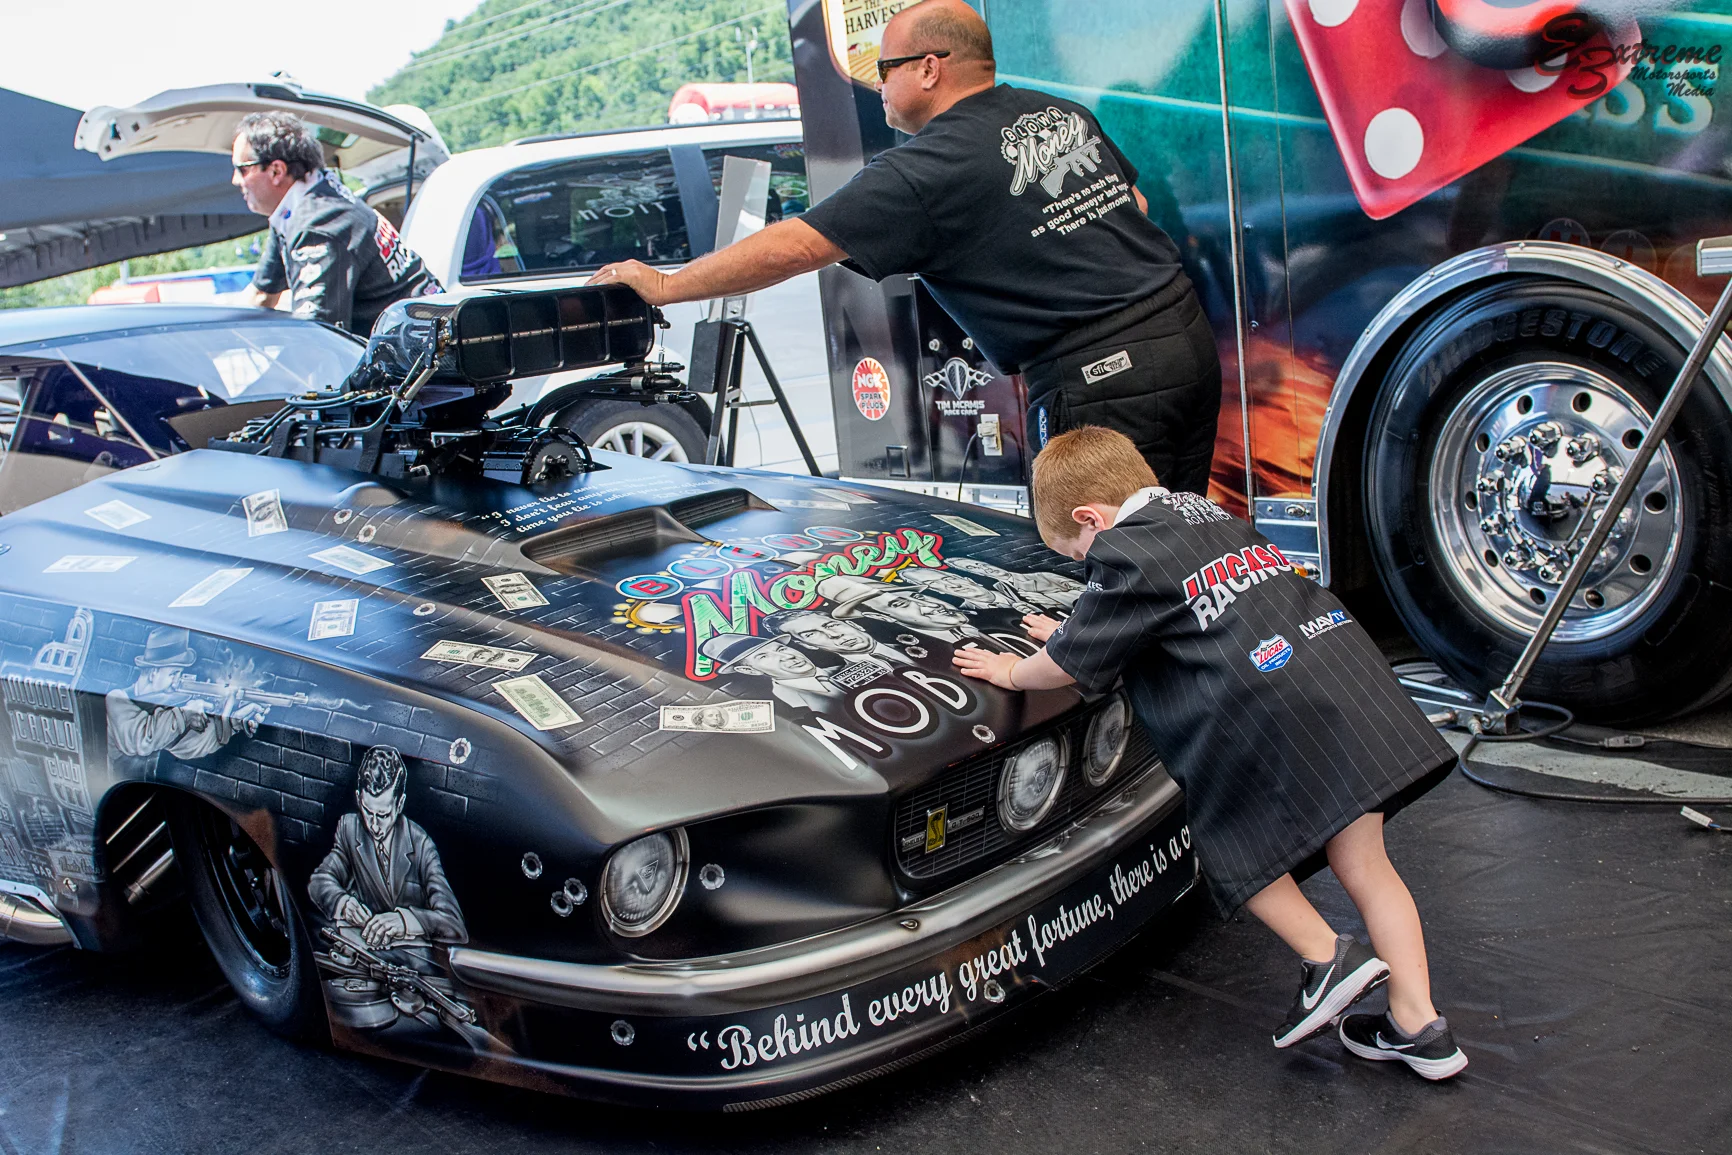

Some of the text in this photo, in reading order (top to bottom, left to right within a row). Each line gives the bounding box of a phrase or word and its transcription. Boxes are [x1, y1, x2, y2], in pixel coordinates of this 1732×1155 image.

[1002, 107, 1063, 143] BLOWN
[1010, 112, 1088, 196] Money
[1081, 187, 1091, 197] no
[1030, 225, 1046, 238] as
[1046, 209, 1073, 230] good
[1073, 196, 1099, 215] money
[1057, 216, 1087, 236] There
[1087, 211, 1097, 221] is
[857, 372, 884, 389] NGK
[860, 393, 883, 401] SPARK
[861, 401, 884, 411] PLUGS
[935, 400, 951, 411] TIM
[681, 528, 946, 681] Money
[1191, 561, 1292, 631] RACIN
[1299, 611, 1345, 637] MAVTV
[1259, 641, 1284, 665] LUCAS
[15, 710, 75, 751] CARLO
[47, 752, 80, 783] club
[31, 863, 54, 878] BAR
[868, 971, 953, 1027] every
[958, 929, 1028, 1002] great
[1027, 893, 1114, 967] fortune,
[1109, 864, 1153, 905] there
[1150, 844, 1167, 874] is
[1169, 835, 1182, 861] a
